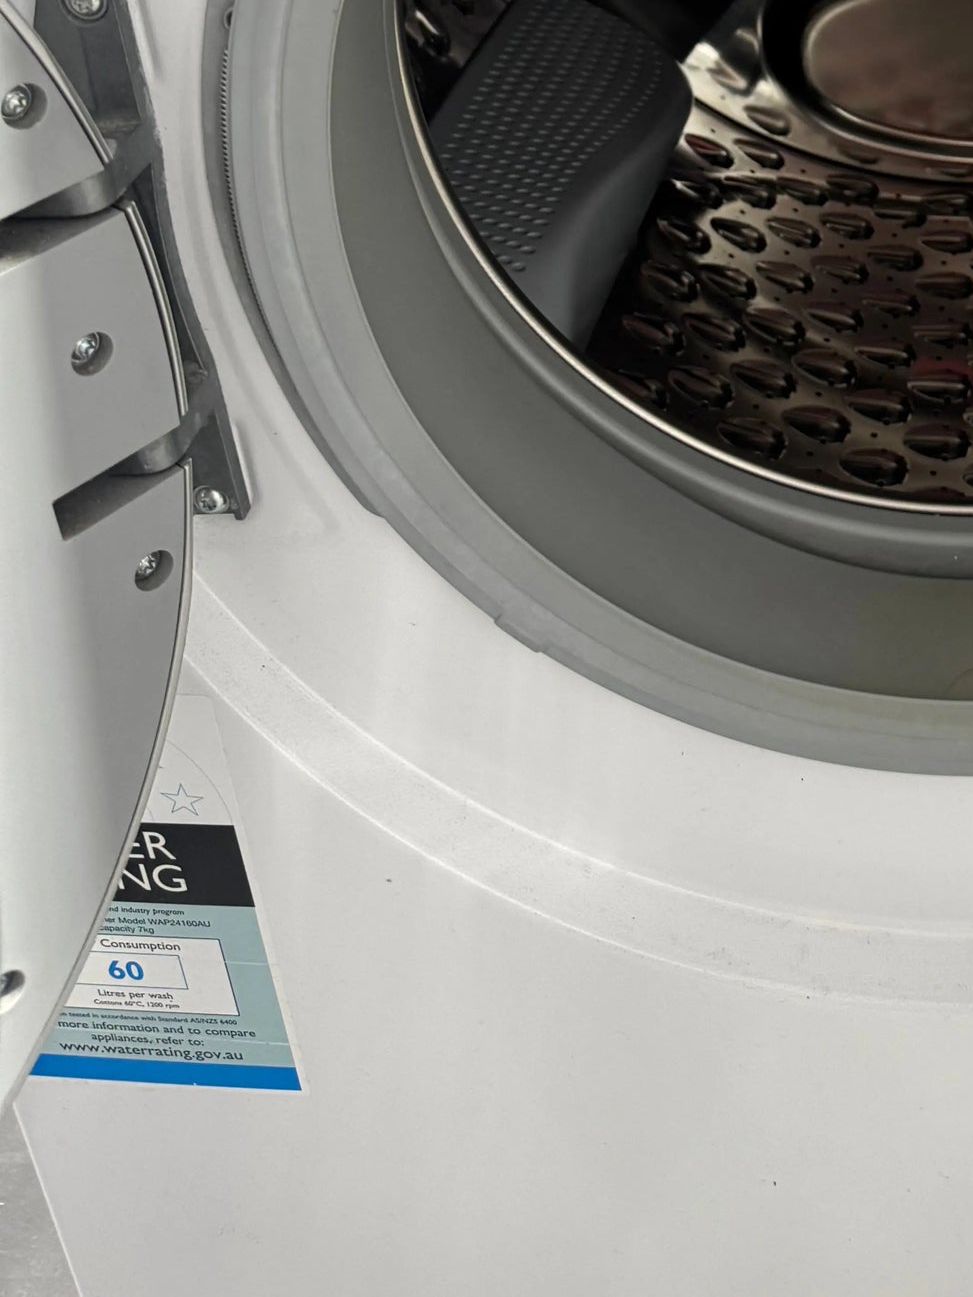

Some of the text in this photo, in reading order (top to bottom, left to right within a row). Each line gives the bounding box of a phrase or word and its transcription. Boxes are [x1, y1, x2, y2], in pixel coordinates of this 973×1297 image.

[121, 906, 150, 915] industry
[152, 908, 185, 917] program
[117, 916, 147, 925] Model
[137, 925, 155, 935] 7kg
[99, 938, 181, 952] Consumption
[108, 959, 144, 981] 60
[97, 988, 174, 1000] Litres per wash
[93, 998, 122, 1006] Cottons
[100, 1013, 139, 1021] accordance
[157, 1015, 189, 1023] Standard
[57, 1021, 256, 1039] more information and to compare
[155, 1036, 184, 1045] refer
[187, 1038, 205, 1047] to:
[59, 1041, 244, 1061] www.waterrating.gov.au
